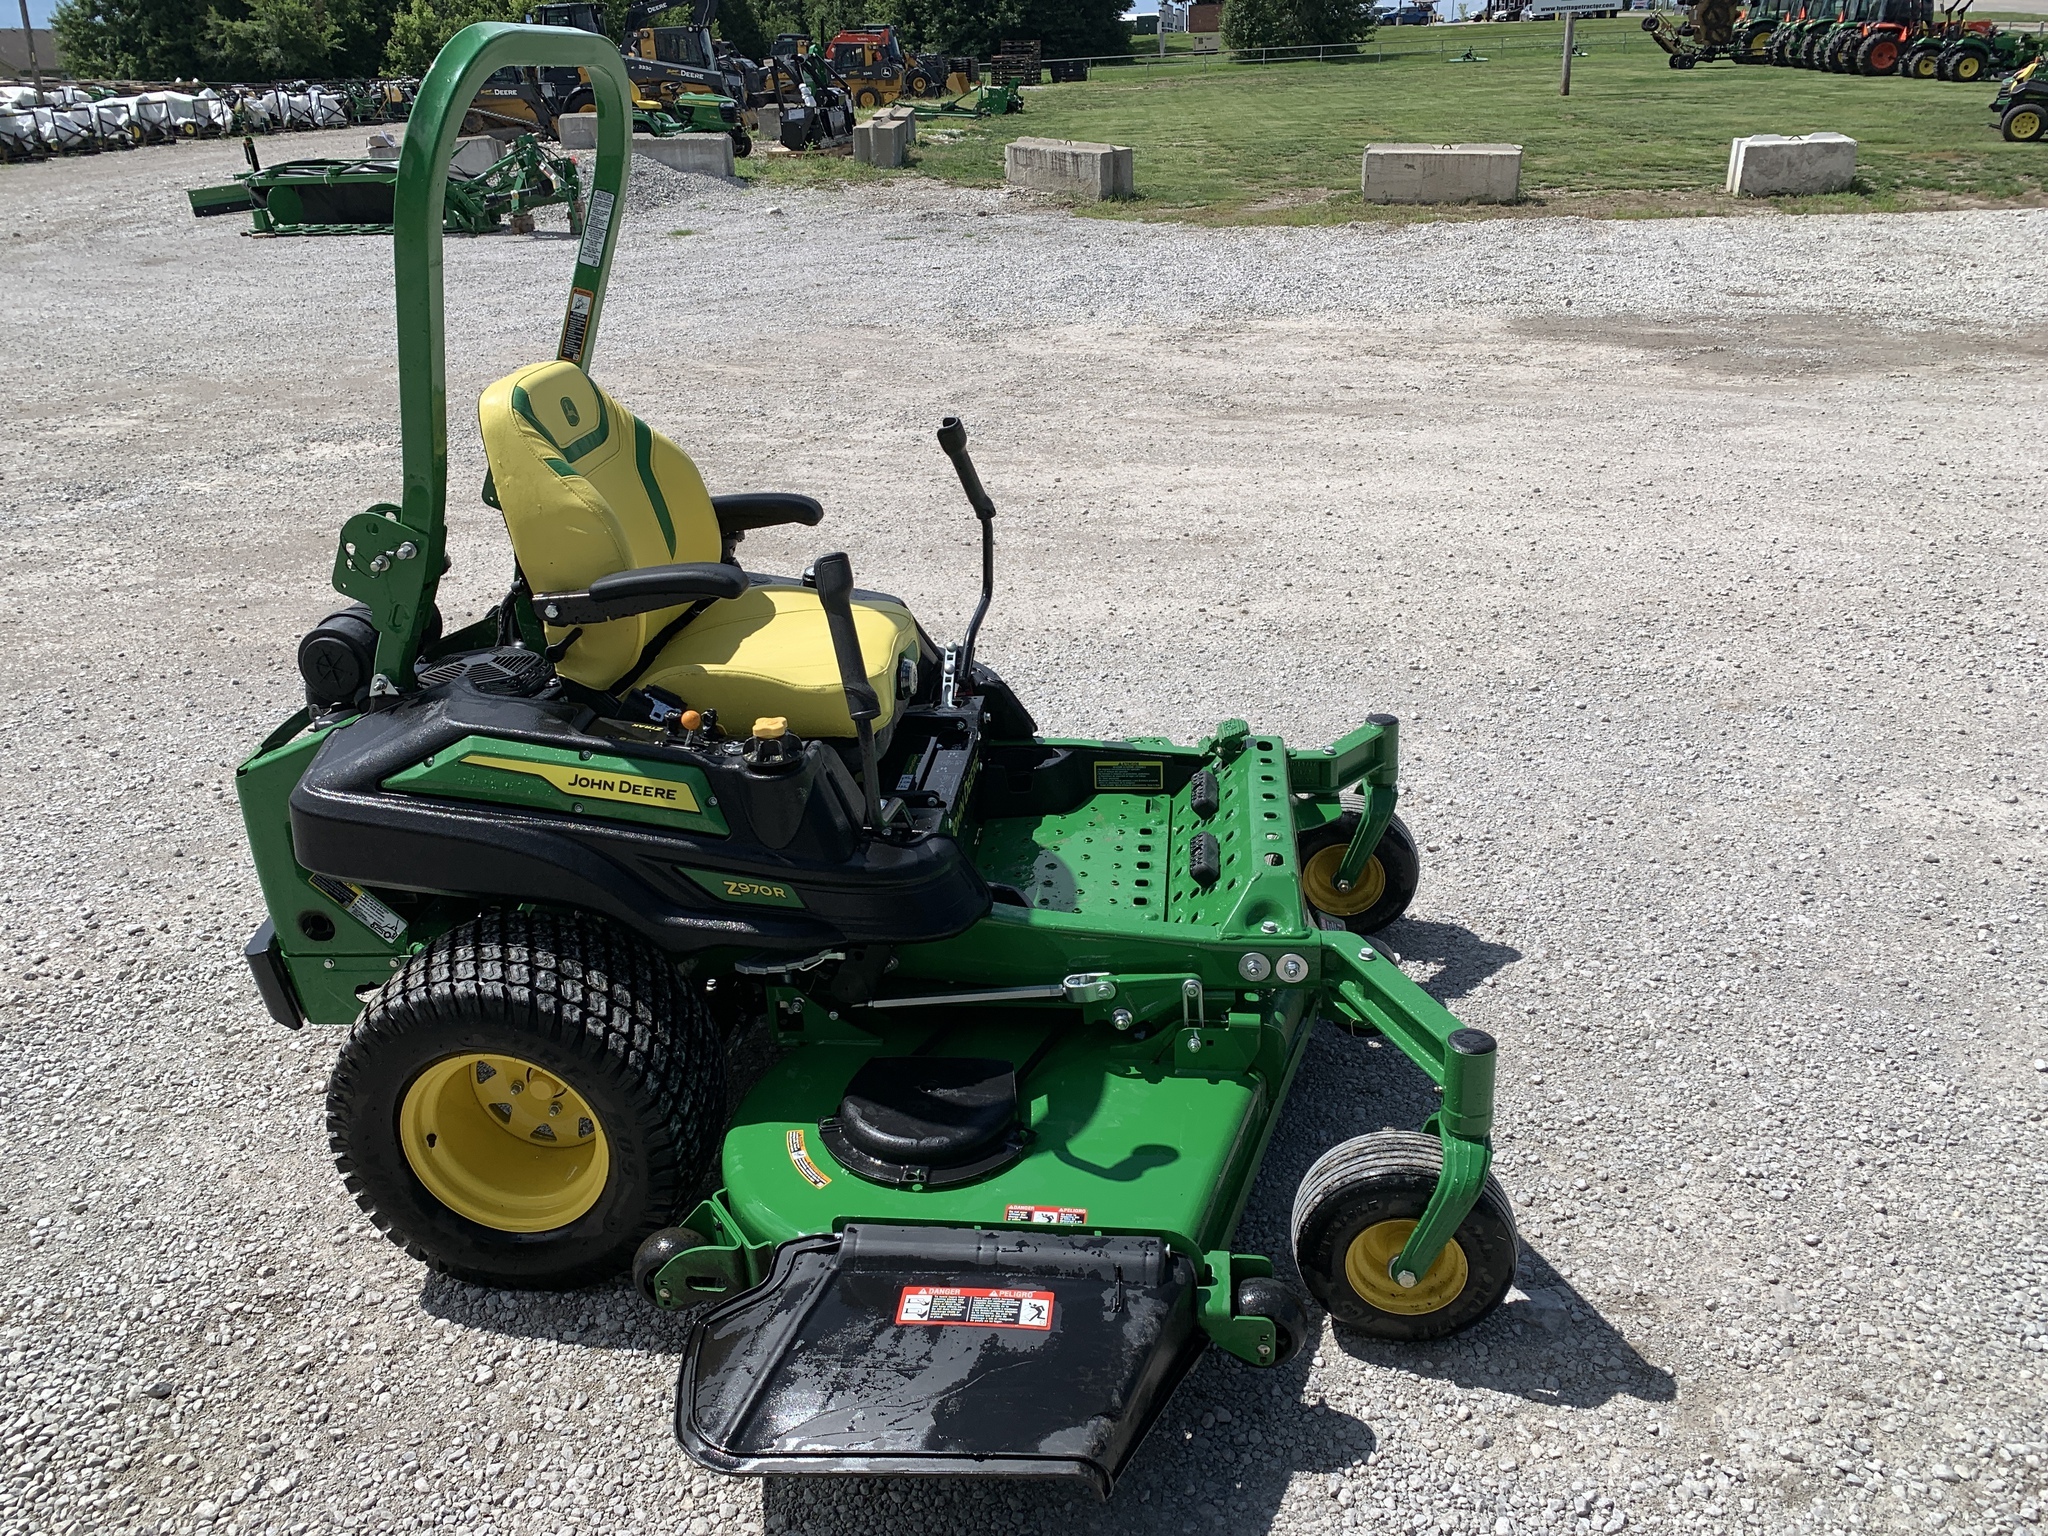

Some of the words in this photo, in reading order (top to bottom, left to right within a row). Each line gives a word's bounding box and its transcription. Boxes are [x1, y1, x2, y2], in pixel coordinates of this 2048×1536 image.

[647, 2, 668, 14] DEERE
[1540, 2, 1616, 12] www.heritagetractor.com
[680, 69, 704, 80] DEERE
[494, 88, 518, 96] DEERE
[567, 772, 615, 791] JOHN
[618, 780, 678, 801] DEERE
[722, 880, 787, 899] Z970R
[928, 1288, 961, 1296] DANGER
[999, 1290, 1034, 1299] PELIGRO
